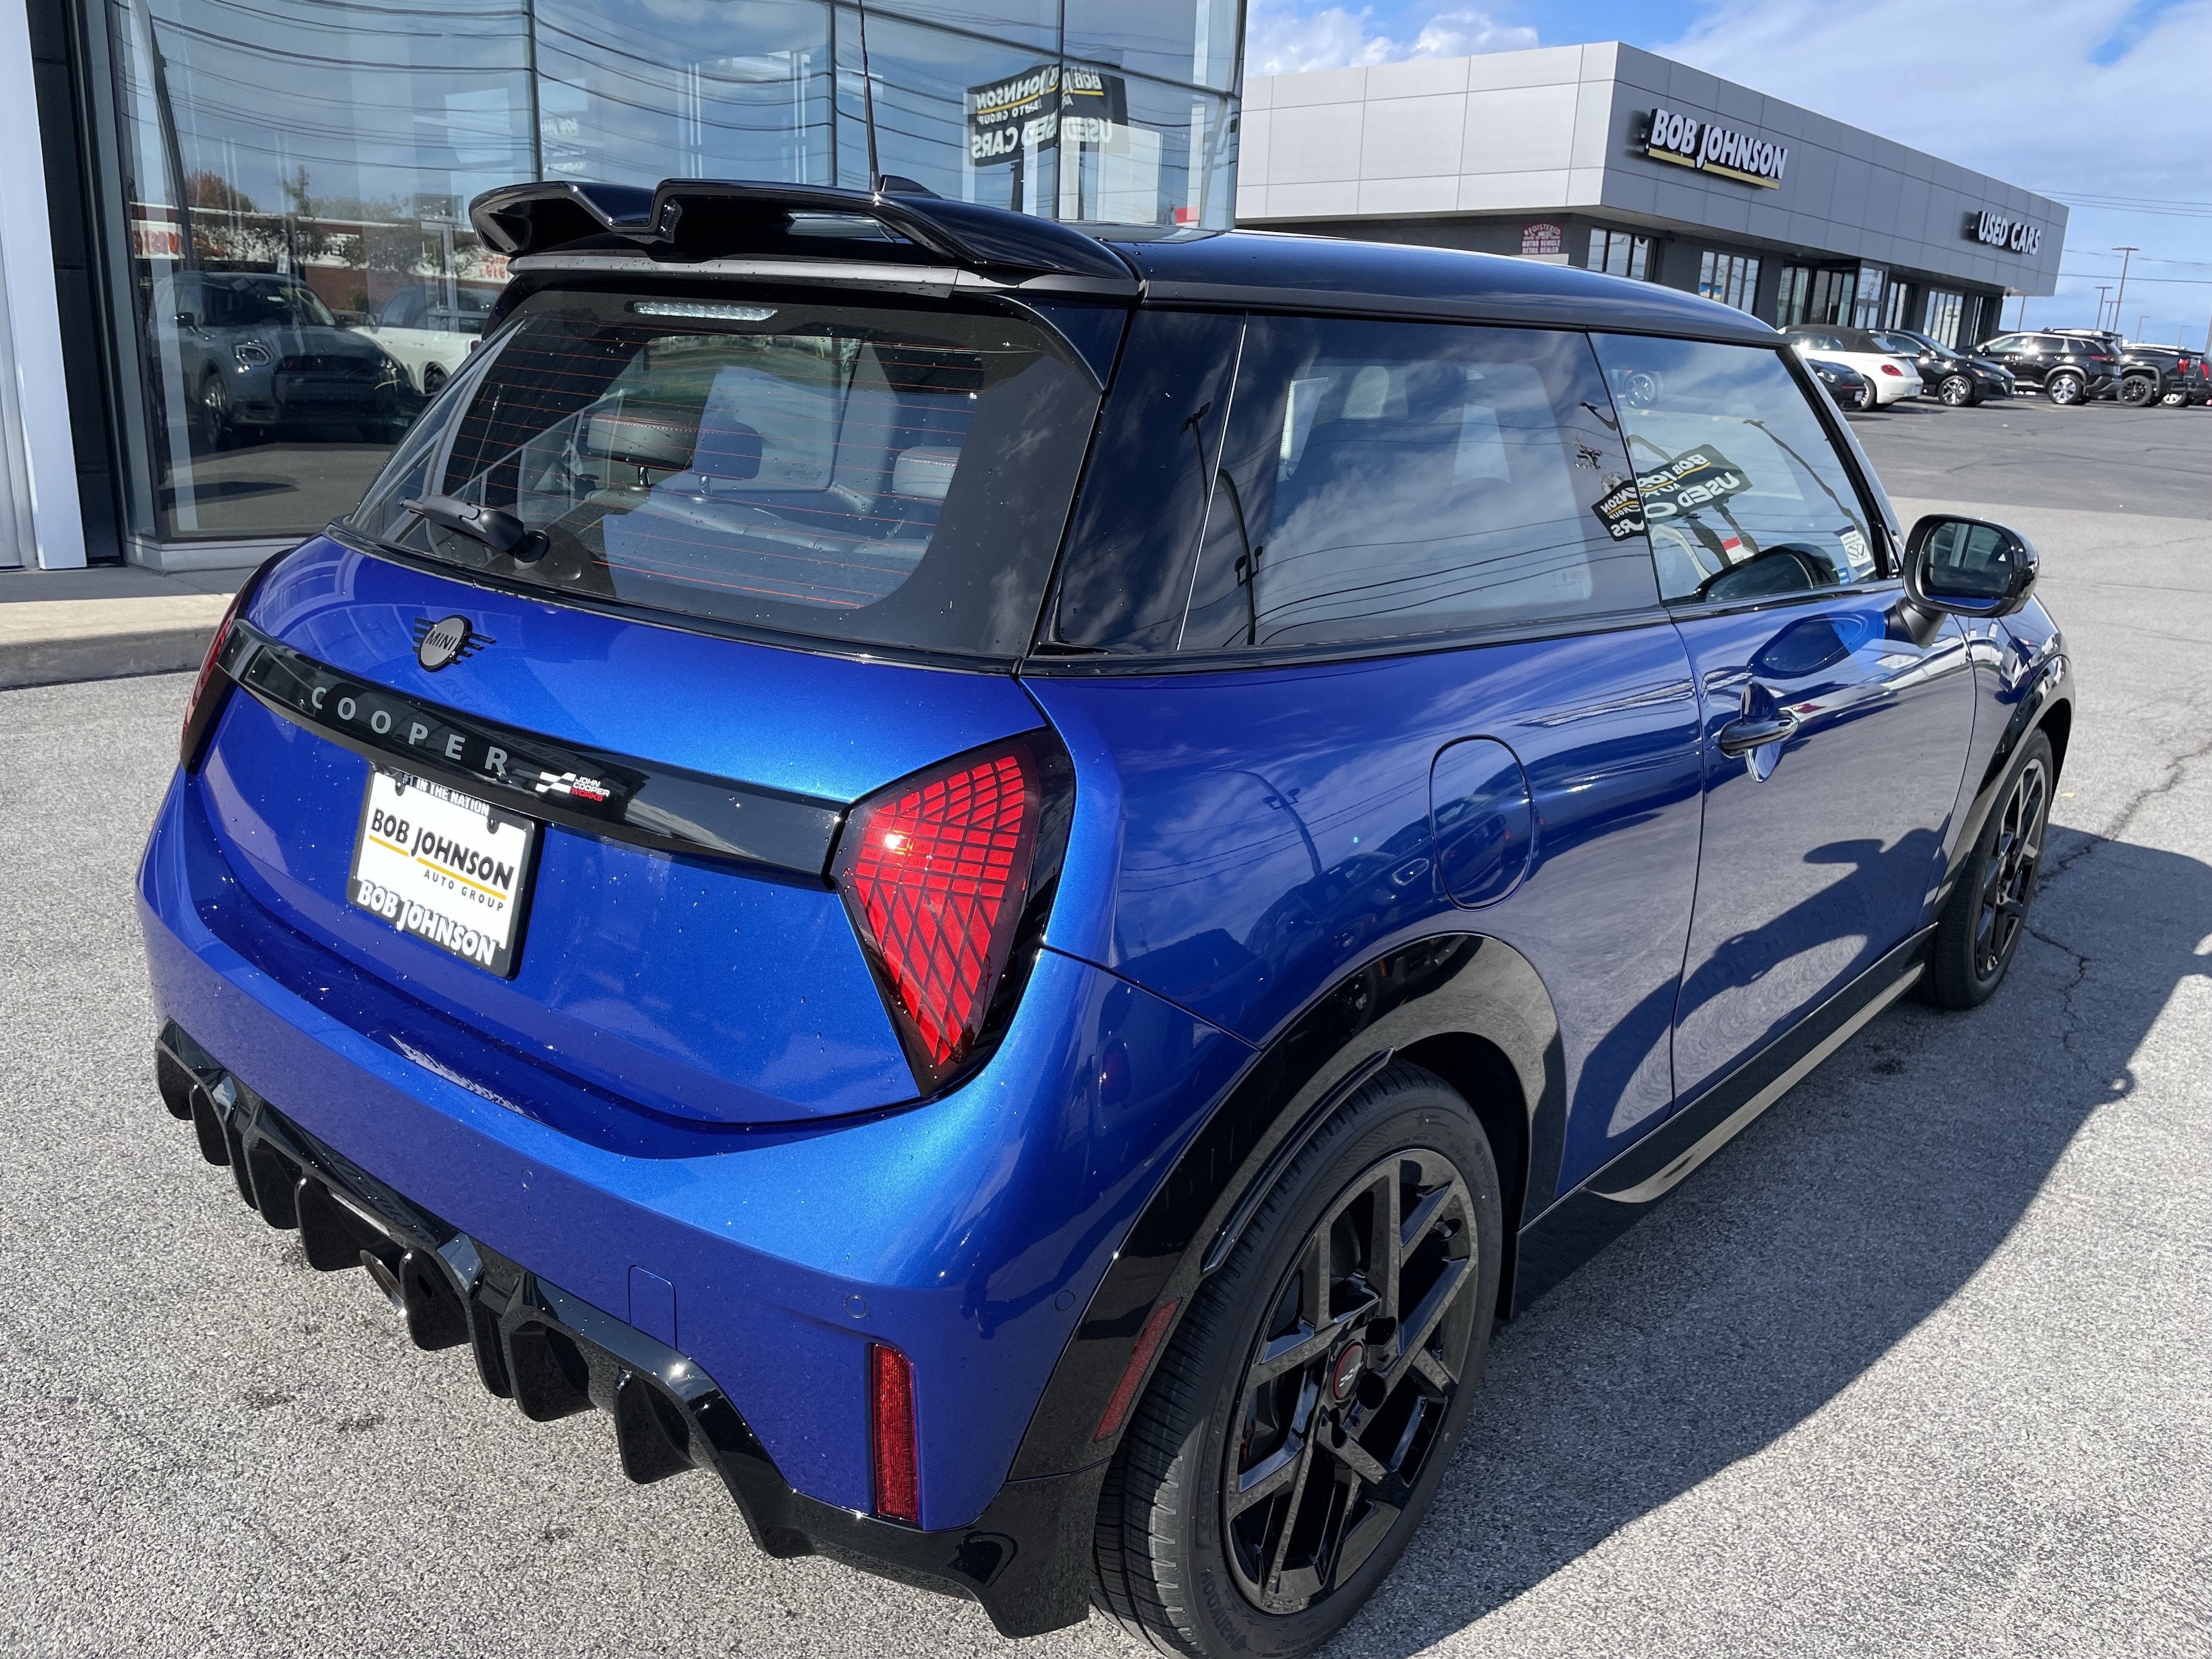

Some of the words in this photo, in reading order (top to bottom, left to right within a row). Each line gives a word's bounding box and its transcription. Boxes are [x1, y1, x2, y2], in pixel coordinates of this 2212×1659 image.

[1650, 108, 1697, 154] BOB
[1696, 124, 1788, 179] JOHNSON
[1978, 211, 2008, 246] USED
[2011, 222, 2041, 255] CARS
[426, 631, 457, 651] MINI
[311, 687, 508, 776] COOPER
[416, 778, 428, 792] IN
[430, 784, 449, 801] THE
[450, 791, 490, 816] NATION
[572, 788, 602, 802] WORKS
[573, 782, 610, 797] COOPER
[575, 776, 601, 788] JOHN
[370, 807, 410, 844] BOB
[411, 827, 515, 891] JOHNSON
[424, 868, 454, 890] AUTO
[461, 887, 504, 912] GROUP
[357, 879, 400, 918] BOB
[396, 900, 498, 966] JOHNSON
